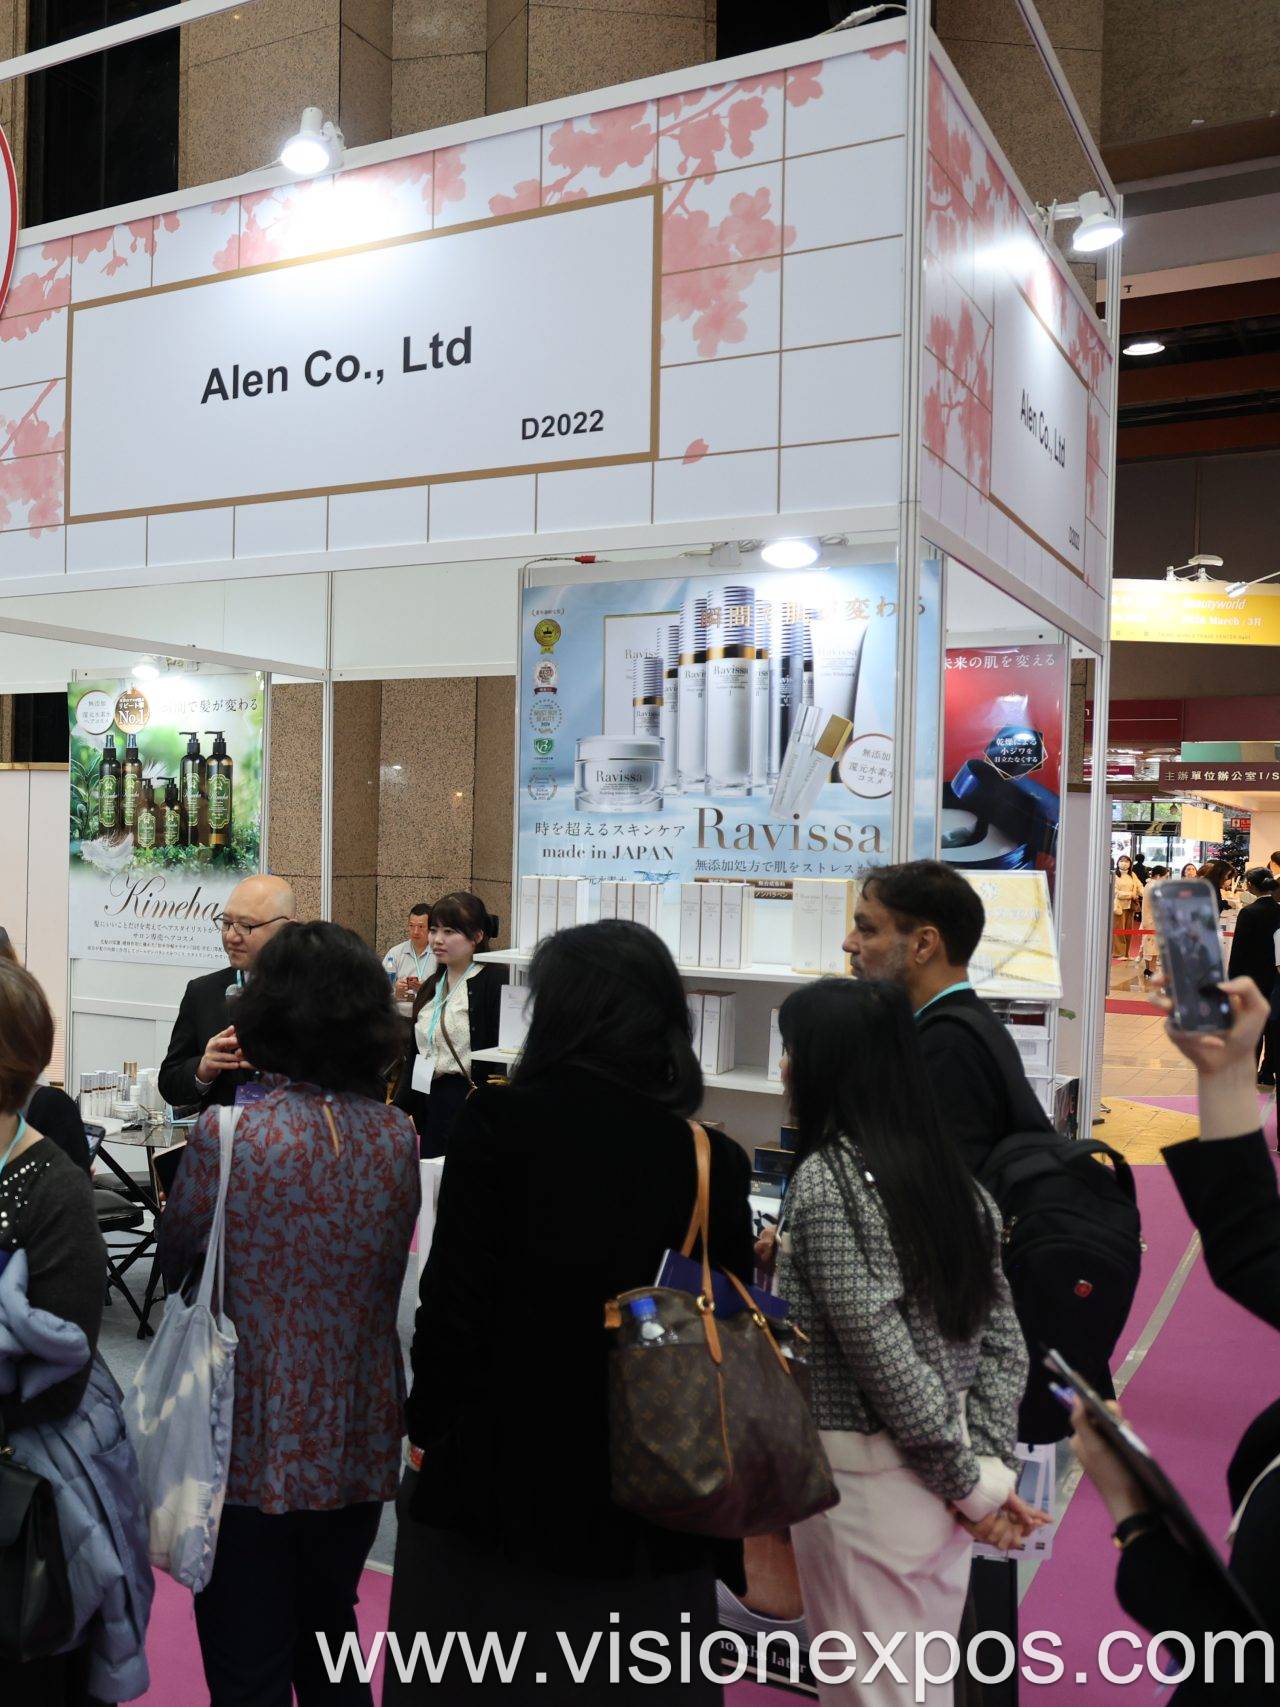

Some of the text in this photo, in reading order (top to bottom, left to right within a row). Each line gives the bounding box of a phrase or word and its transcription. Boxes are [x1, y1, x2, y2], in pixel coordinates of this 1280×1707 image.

[201, 326, 471, 404] Alen Co., Ltd
[522, 410, 603, 440] D2022
[1021, 388, 1037, 437] Alen
[1054, 428, 1066, 468] Ltd
[700, 596, 925, 629] 瞬間で肌変わ
[1183, 599, 1246, 610] utyworld
[625, 649, 655, 660] Ravis
[944, 654, 1055, 670] 未来の肌を変える
[685, 670, 706, 679] Ravi
[714, 665, 749, 676] Ravissa
[160, 698, 258, 713] 間で髪が変わる
[118, 710, 145, 725] No.1
[1001, 747, 1033, 755] 小ジワを
[596, 769, 642, 782] Ravissa
[535, 821, 685, 839] 時を超えるスキンケア
[692, 807, 889, 853] Ravissa
[543, 844, 674, 860] made in JAPAN
[104, 872, 220, 920] Kimeha
[772, 1651, 806, 1673] latr
